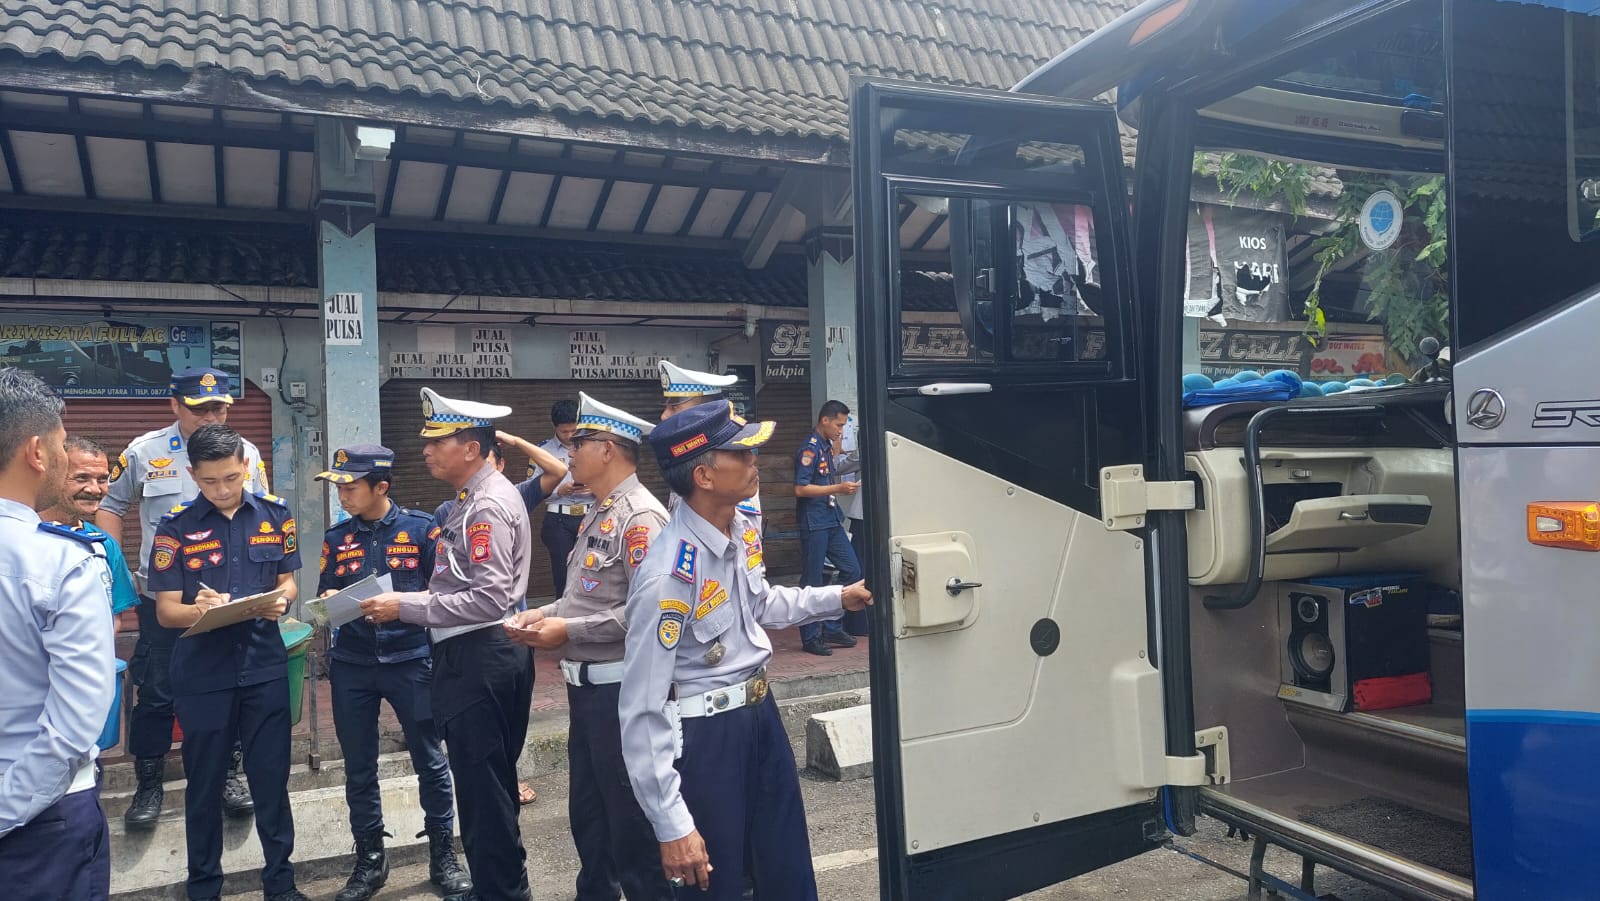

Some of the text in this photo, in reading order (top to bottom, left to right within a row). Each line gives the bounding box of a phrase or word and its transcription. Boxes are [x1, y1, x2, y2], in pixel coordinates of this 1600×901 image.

[1239, 236, 1267, 250] KIOS
[1234, 261, 1279, 284] ARI
[329, 294, 358, 314] JUAL
[0, 325, 167, 343] RIWISATA FULL AC
[326, 319, 362, 340] PULSA
[476, 330, 505, 341] JUAL
[573, 331, 601, 342] JUAL
[473, 342, 509, 353] PULSA
[570, 344, 604, 354] PULSA
[394, 354, 425, 365] JUAL
[436, 354, 466, 365] JUAL
[477, 355, 506, 366] JUAL
[574, 356, 601, 366] JUAL
[611, 356, 637, 366] JUAL
[432, 367, 471, 378] PULSA
[473, 367, 510, 378] PULSA
[571, 368, 606, 378] PULSA
[607, 368, 640, 378] PULSA
[765, 364, 805, 379] bakpia
[262, 374, 275, 383] 42
